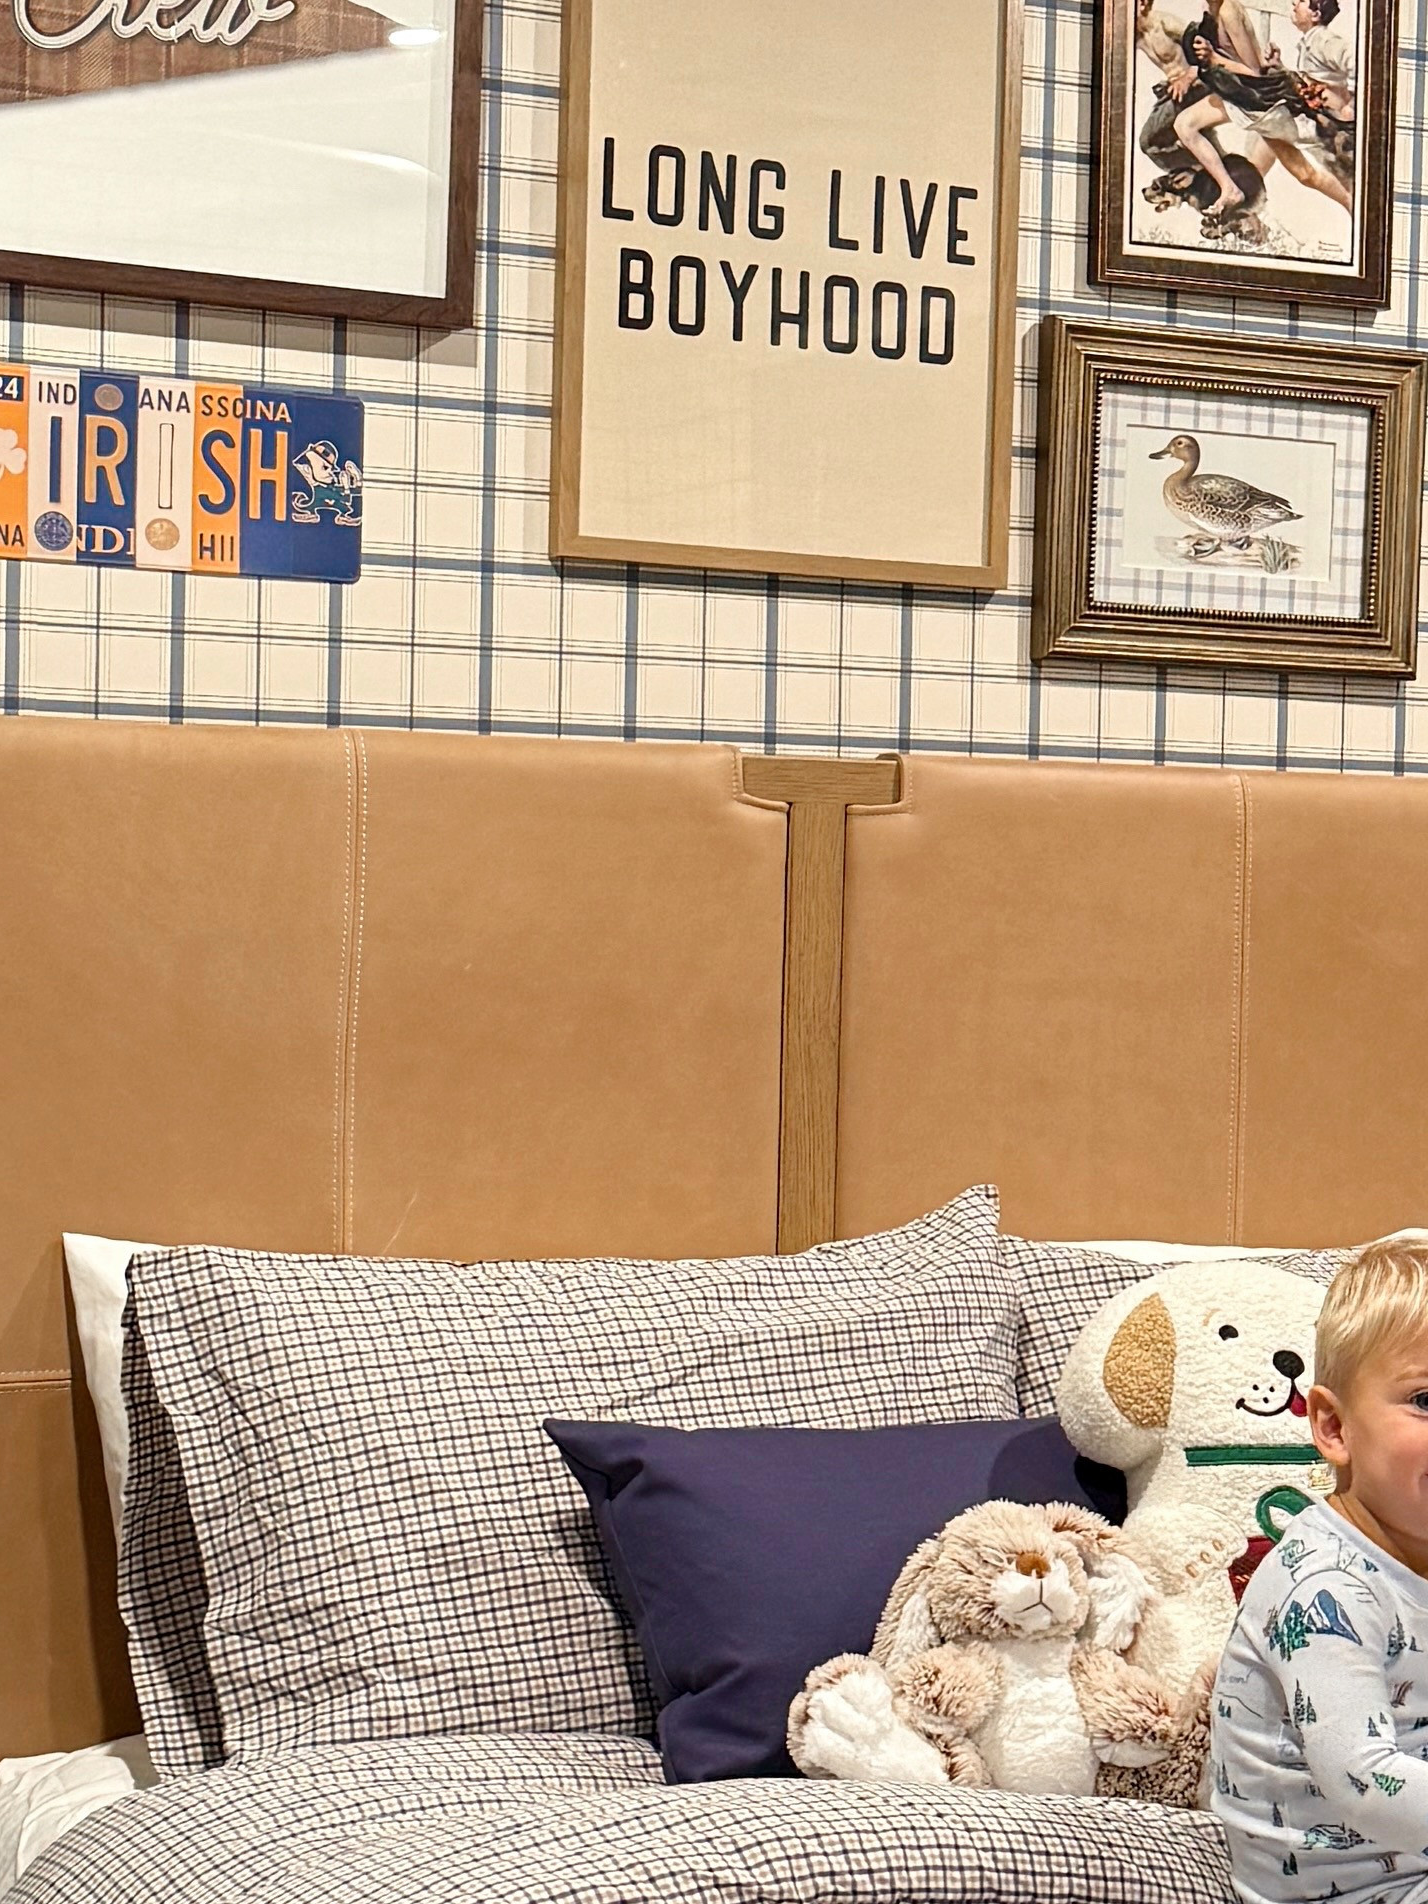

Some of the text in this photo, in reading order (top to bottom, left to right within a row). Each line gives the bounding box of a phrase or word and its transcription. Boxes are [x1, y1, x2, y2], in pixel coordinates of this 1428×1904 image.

[601, 136, 978, 266] LONG LIVE
[617, 247, 956, 366] BOYHOOD
[38, 380, 77, 405] IND
[138, 387, 191, 414] ANA
[48, 412, 289, 522] IRISH
